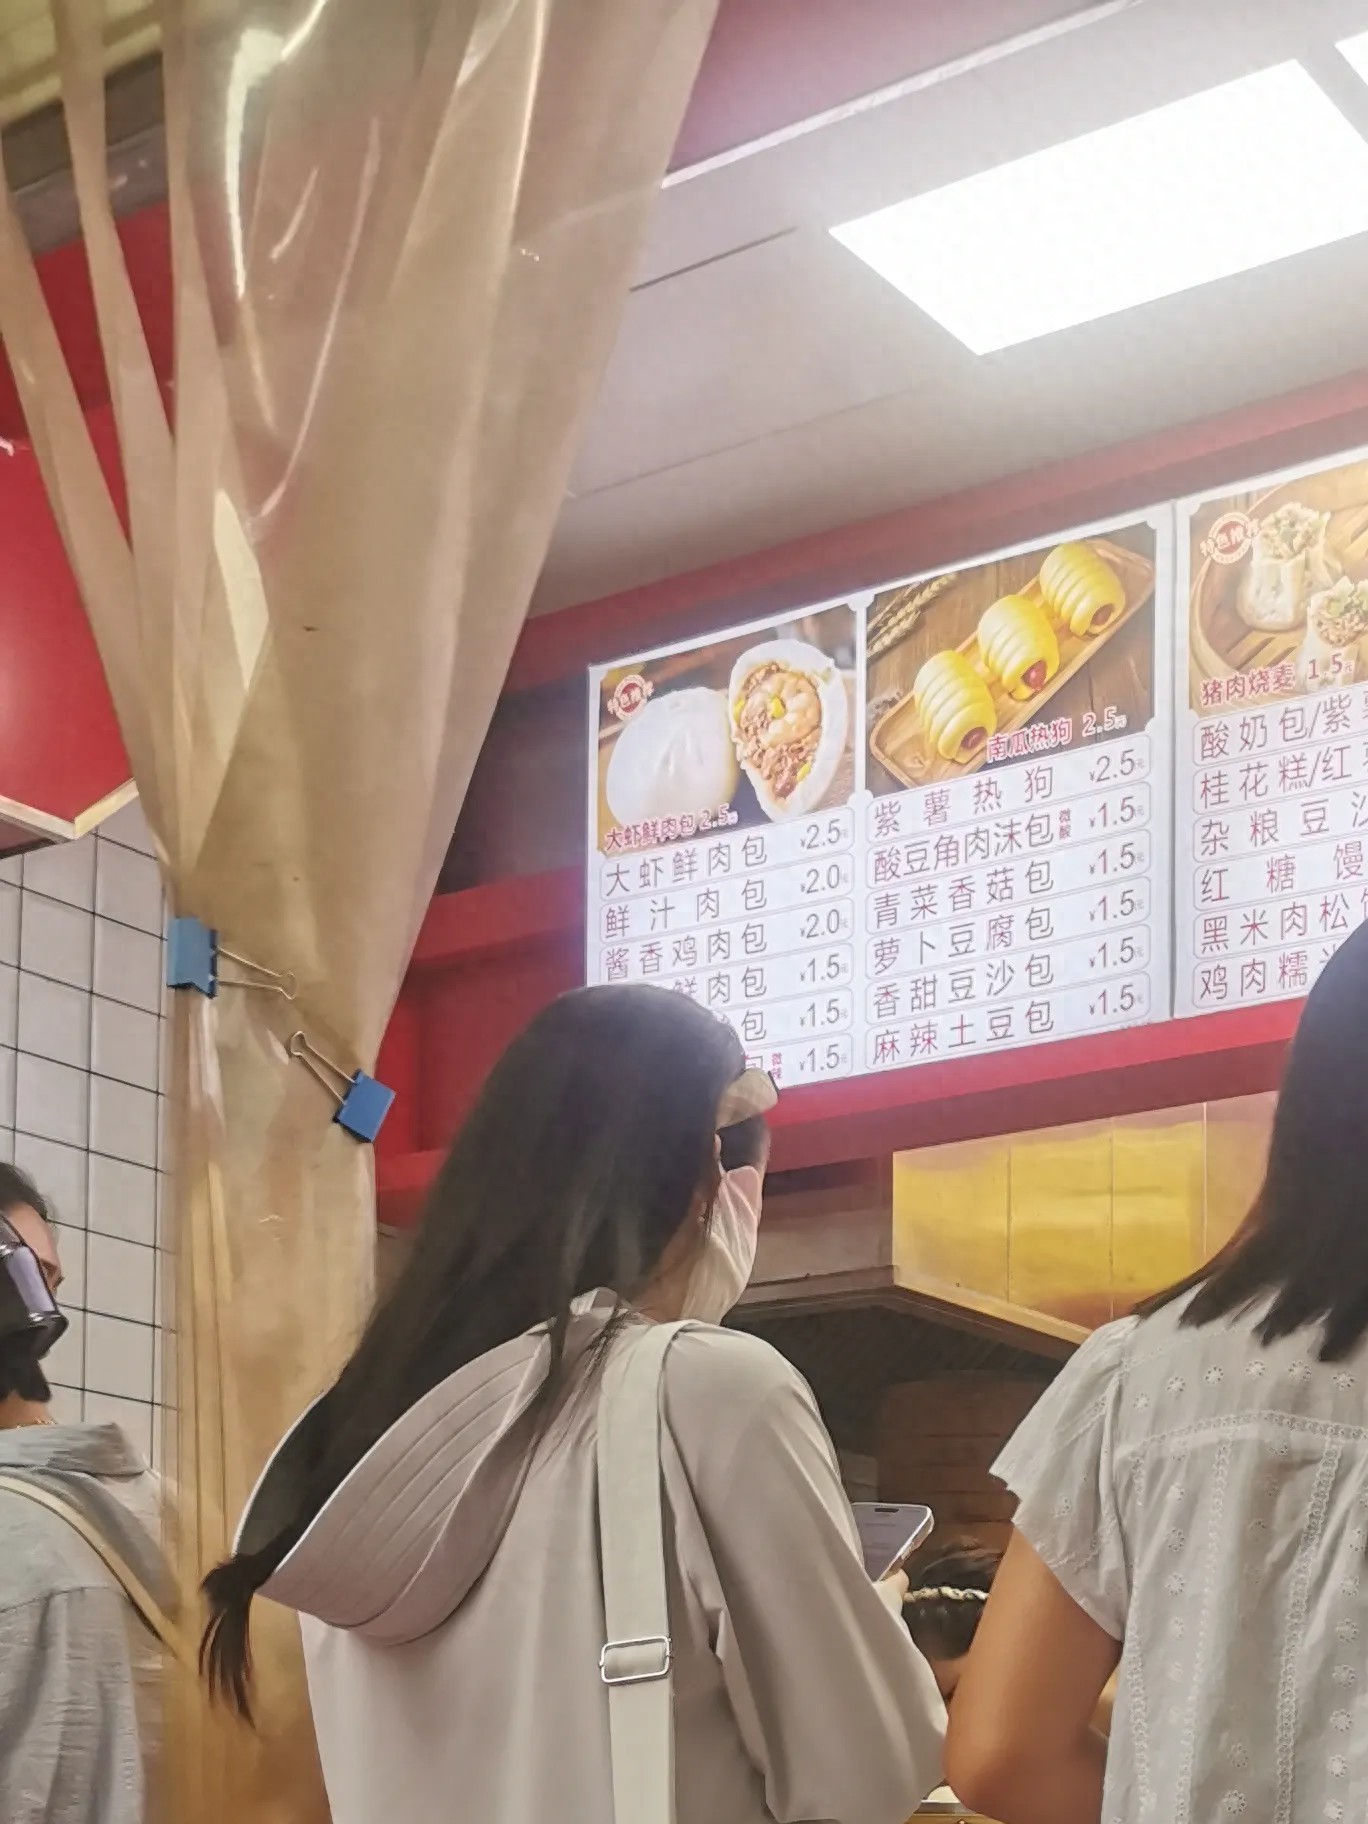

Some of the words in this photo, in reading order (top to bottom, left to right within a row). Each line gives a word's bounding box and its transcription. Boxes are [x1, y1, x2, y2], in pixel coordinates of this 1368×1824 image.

[1200, 663, 1295, 708] 猪肉烧麦
[986, 716, 1073, 763] 南瓜热狗
[606, 812, 695, 852] 大虾鲜肉包
[874, 764, 1054, 838] 紫薯热狗
[605, 835, 767, 897] 大虾鲜肉包
[873, 813, 1054, 884] 酸豆角肉沫包
[605, 878, 767, 938] 鲜汁肉包
[873, 860, 1054, 929] 青菜香菇包
[604, 923, 767, 982] 酱香鸡肉包
[873, 906, 1054, 976] 萝卜豆腐包
[873, 952, 1054, 1019] 香甜豆沙包
[872, 1000, 1054, 1066] 麻辣土豆包
